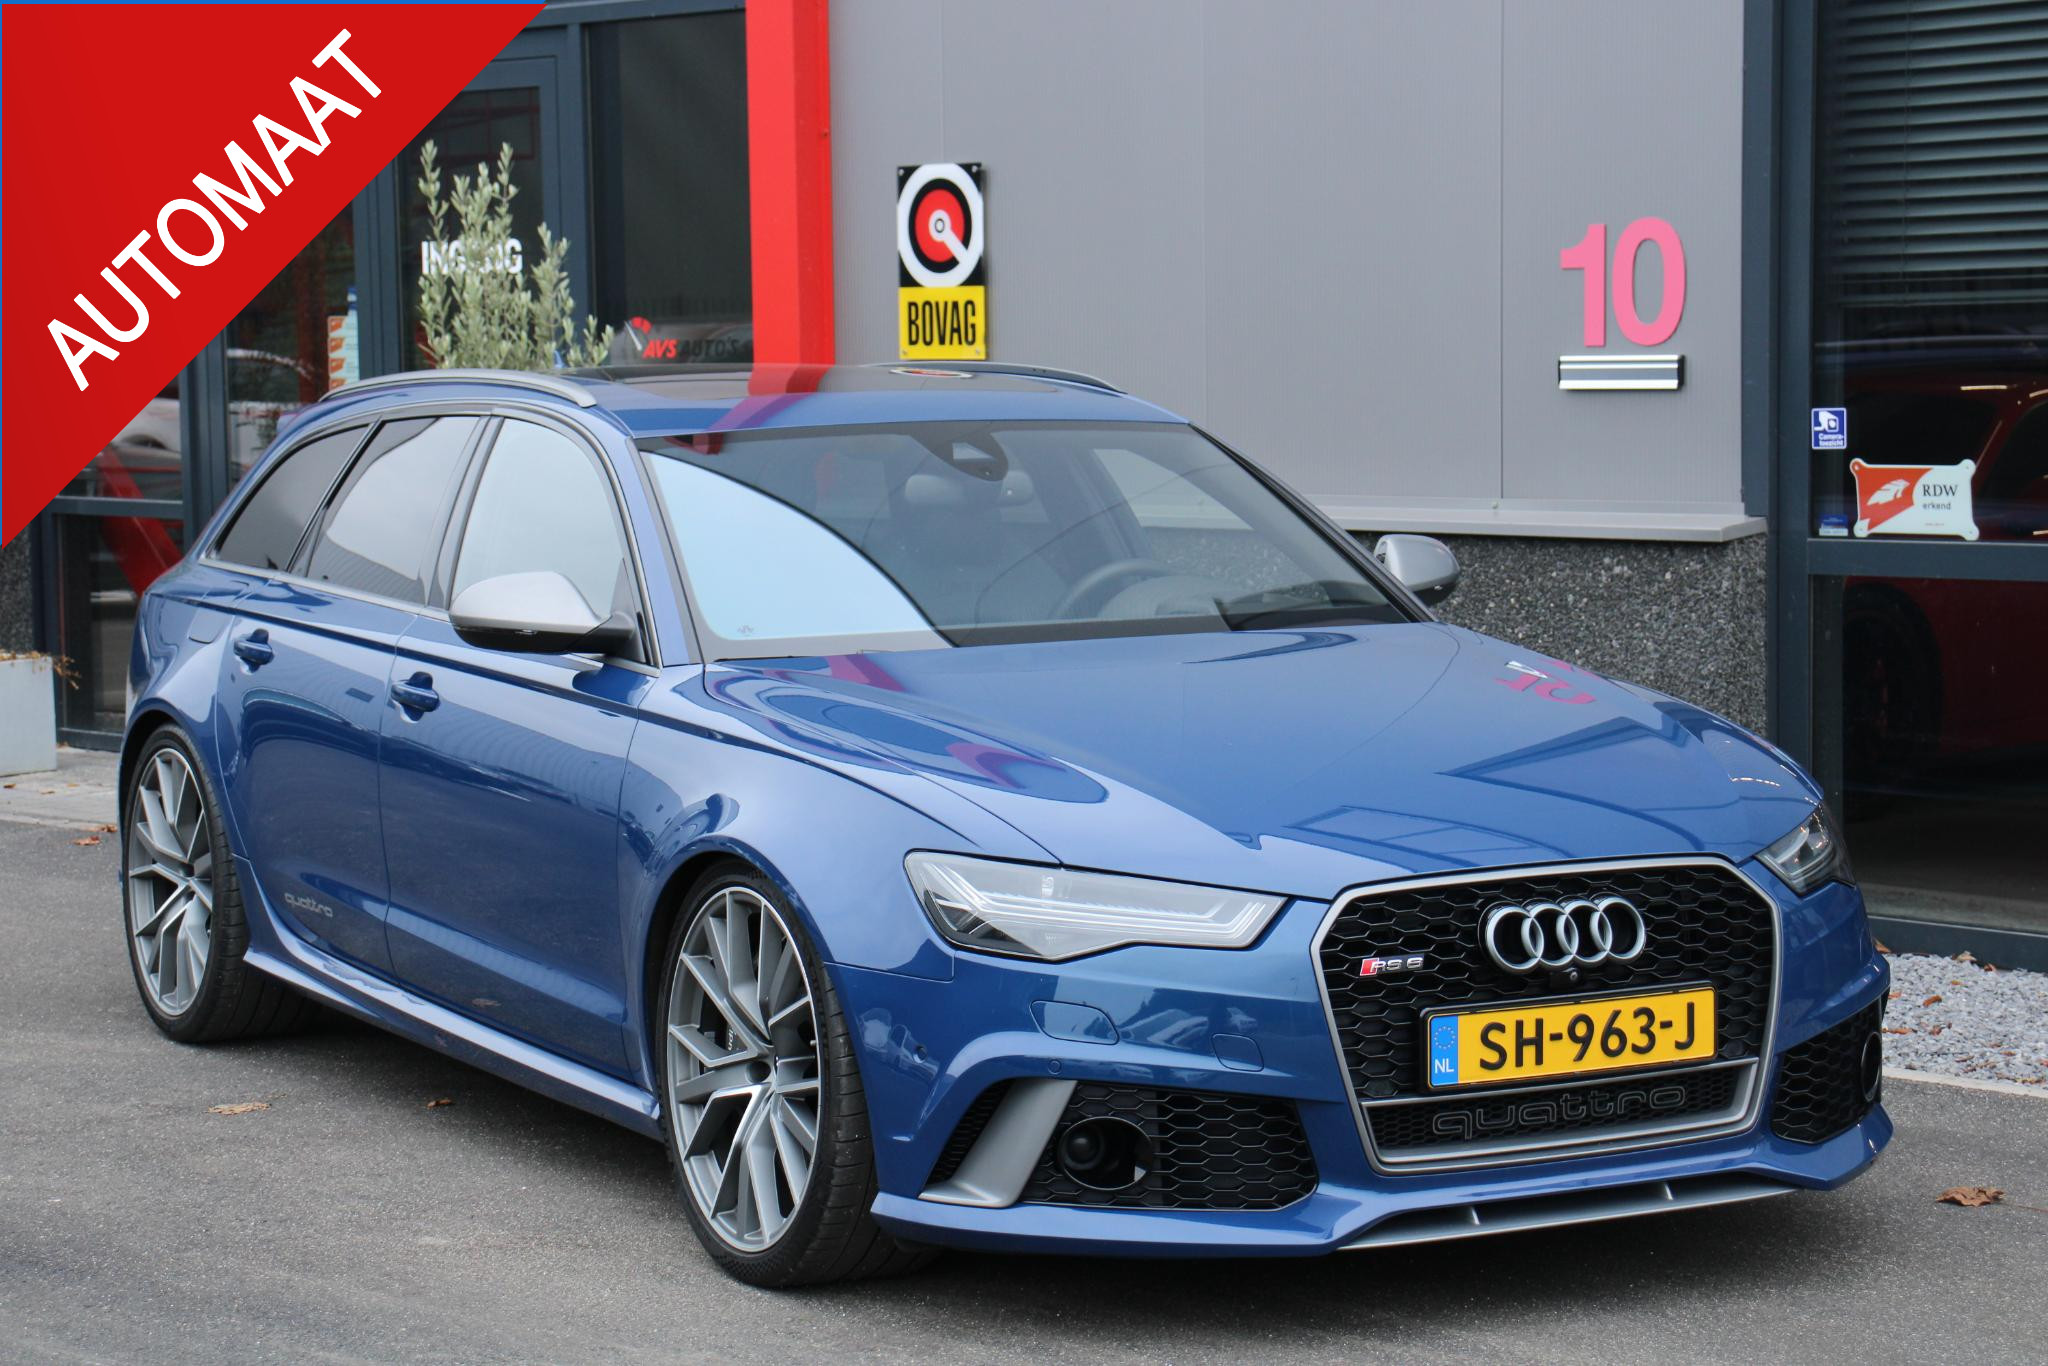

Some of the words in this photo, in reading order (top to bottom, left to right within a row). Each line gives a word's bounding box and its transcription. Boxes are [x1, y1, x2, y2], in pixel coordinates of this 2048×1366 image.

[1560, 216, 1687, 347] 10
[908, 300, 976, 346] BOVAG
[642, 338, 678, 358] AVS
[1922, 484, 1958, 497] RDW
[1922, 502, 1951, 510] erkend
[284, 892, 333, 918] quattro
[1479, 1002, 1695, 1071] SH-963-J
[1434, 1058, 1454, 1074] NL
[1432, 1085, 1686, 1139] quattro
